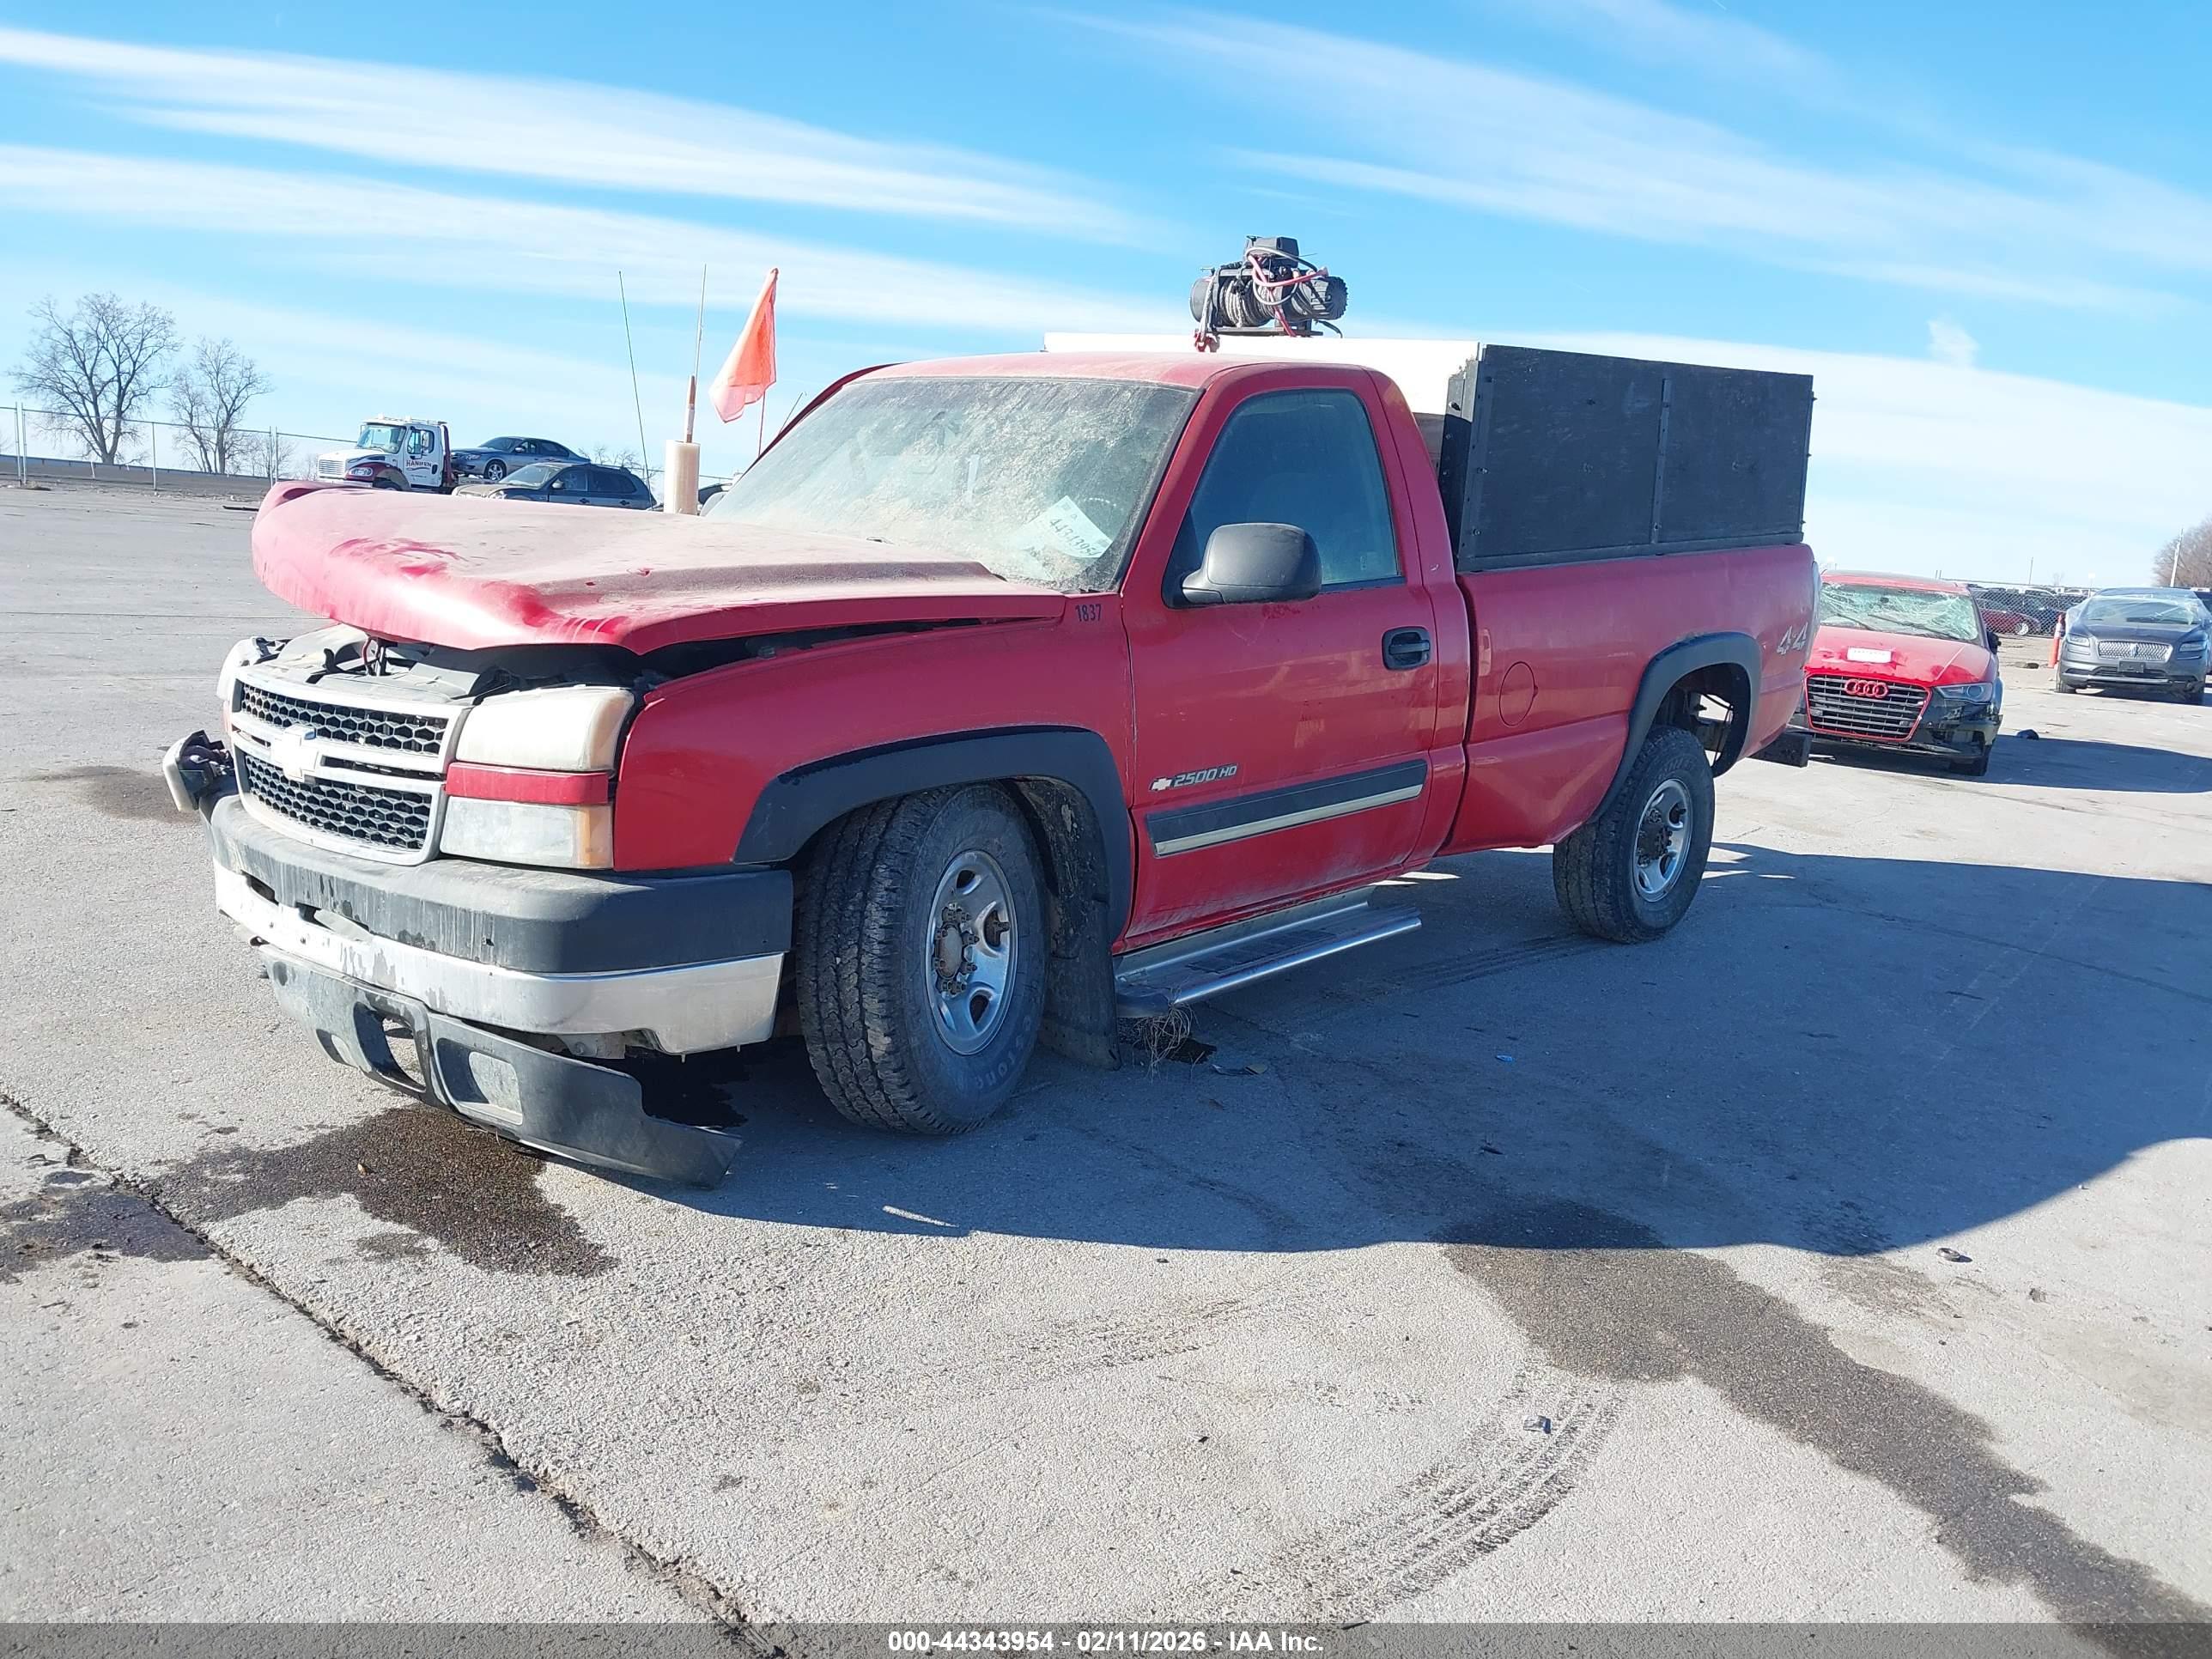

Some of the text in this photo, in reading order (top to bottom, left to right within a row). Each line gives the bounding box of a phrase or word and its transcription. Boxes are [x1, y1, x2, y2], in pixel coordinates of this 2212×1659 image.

[1075, 604, 1102, 622] 1837
[1174, 765, 1237, 787] 2500 HD
